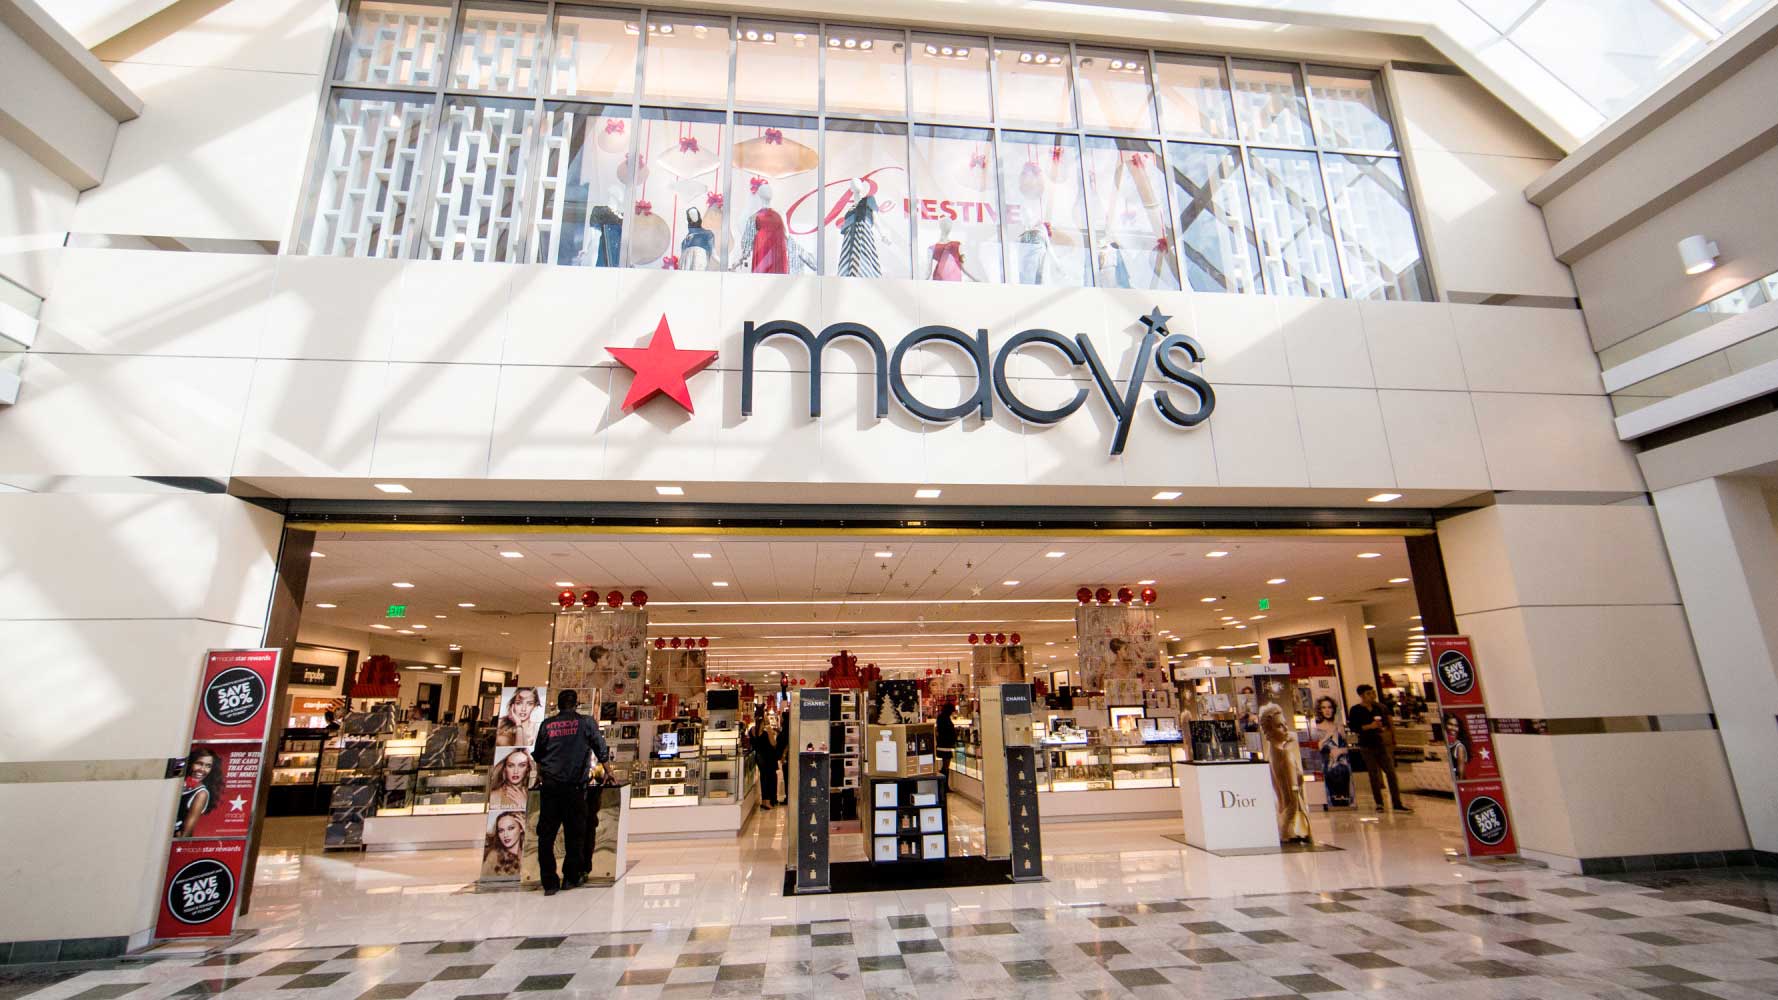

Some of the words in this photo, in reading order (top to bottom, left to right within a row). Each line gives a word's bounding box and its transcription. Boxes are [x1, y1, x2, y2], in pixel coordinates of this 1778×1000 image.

[903, 197, 1021, 225] FESTIVE
[741, 305, 1217, 457] macy's
[1444, 661, 1465, 674] SAVE
[1447, 669, 1468, 683] 20%
[218, 681, 252, 699] SAVE
[218, 691, 253, 711] 20%
[1219, 790, 1257, 809] Dior
[1474, 808, 1497, 822] SAVE
[1478, 816, 1501, 833] 20%
[183, 876, 219, 895] SAVE
[183, 887, 220, 908] 20%
